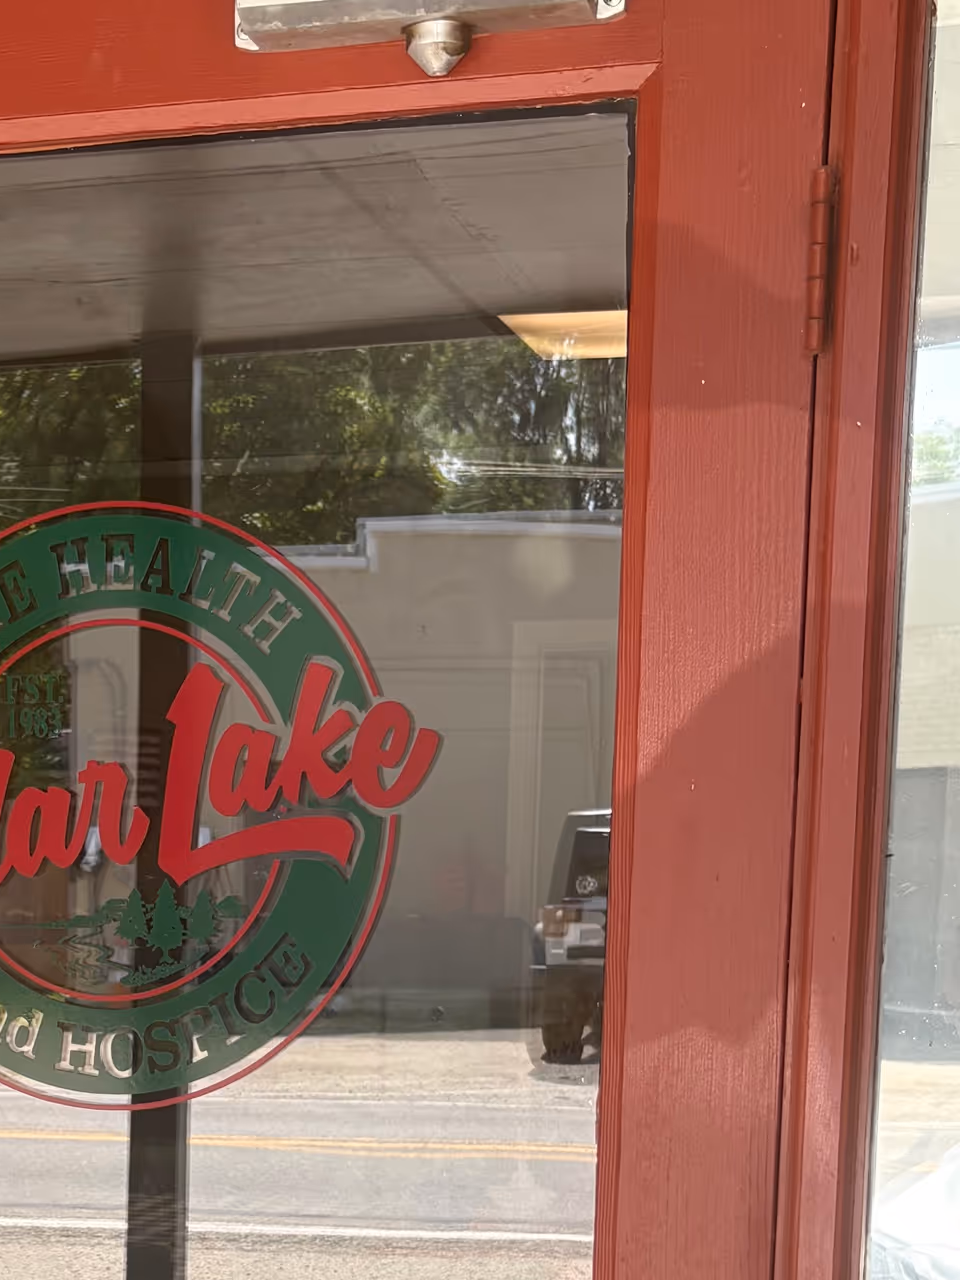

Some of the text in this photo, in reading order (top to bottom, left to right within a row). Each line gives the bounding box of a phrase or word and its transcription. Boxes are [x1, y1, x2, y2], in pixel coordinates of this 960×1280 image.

[49, 533, 303, 655] HEALTH
[158, 660, 439, 886] Lake
[55, 933, 313, 1077] HOSPICE
